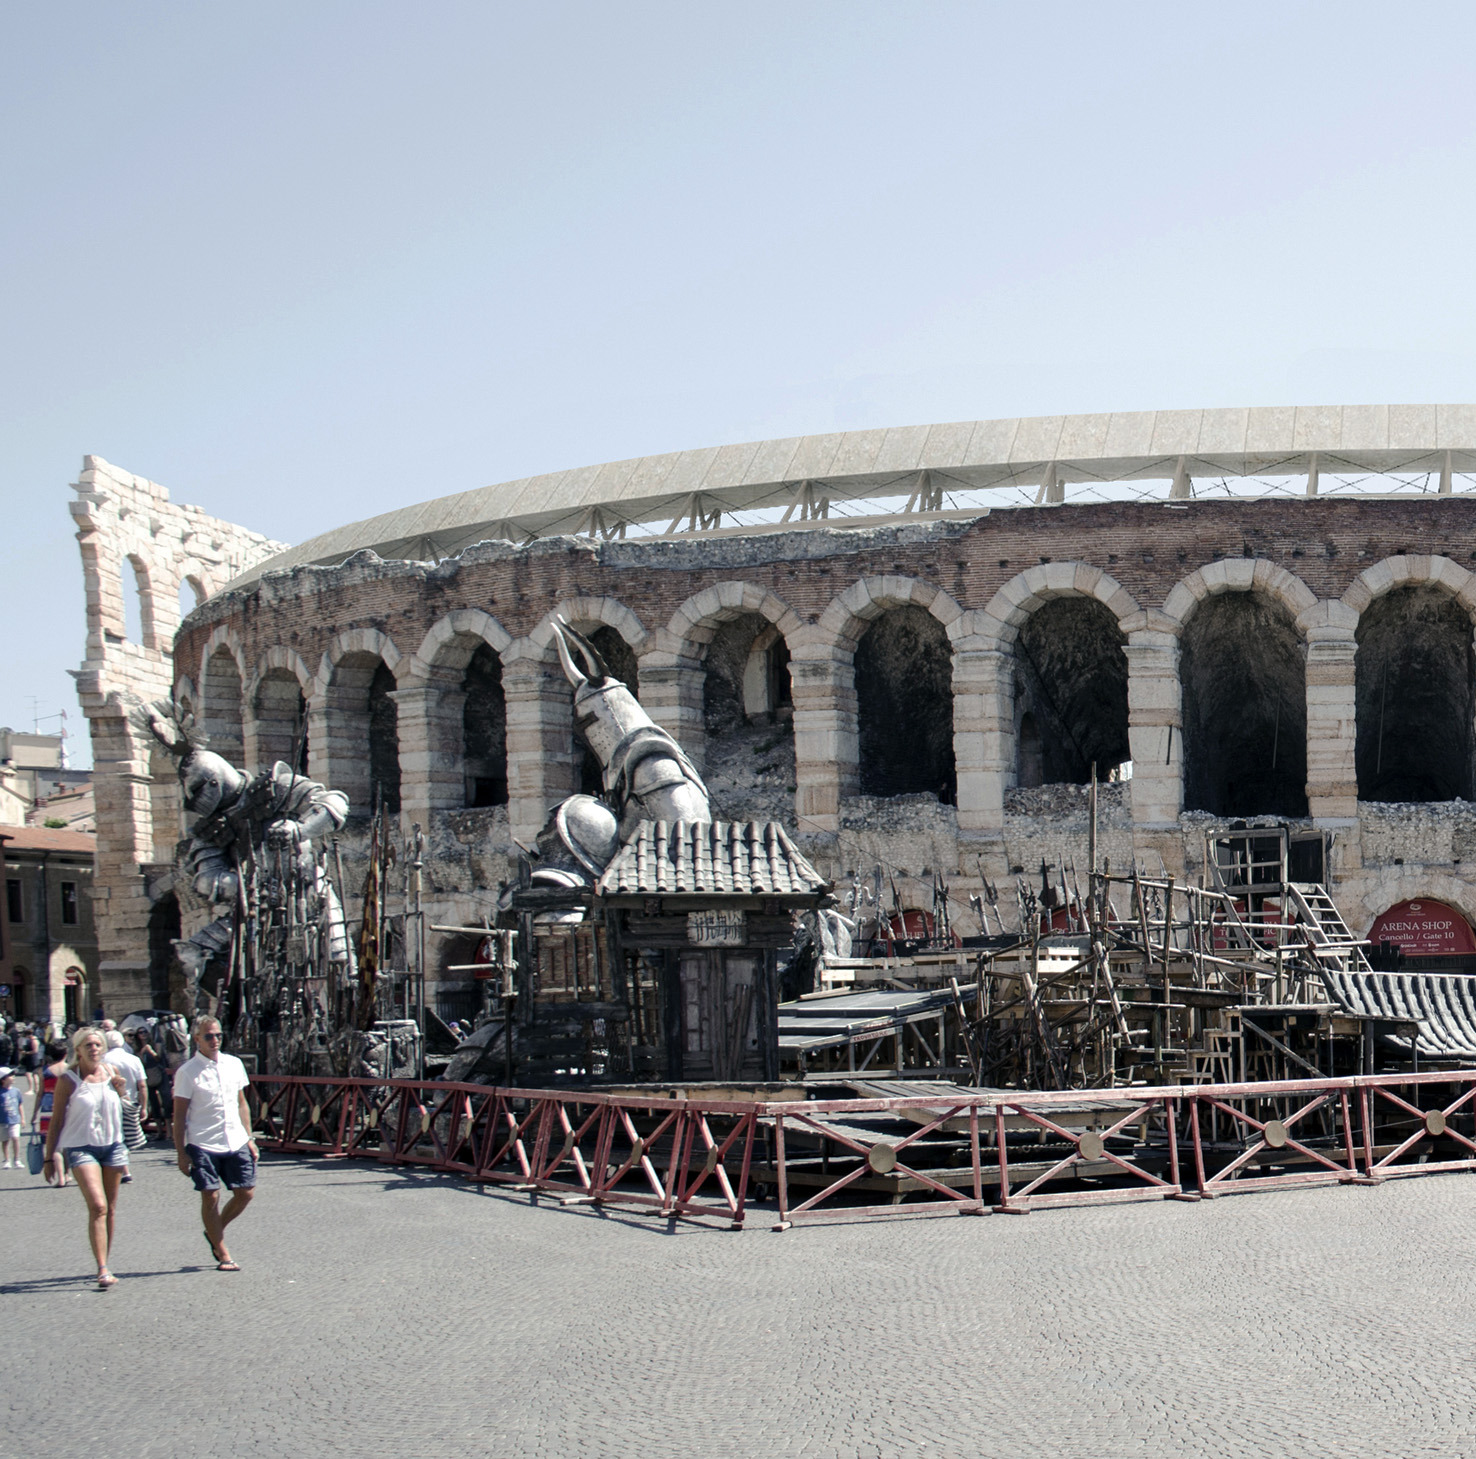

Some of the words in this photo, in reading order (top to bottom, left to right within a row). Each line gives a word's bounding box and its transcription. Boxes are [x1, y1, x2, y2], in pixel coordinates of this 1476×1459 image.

[1381, 921, 1420, 931] ARENA
[1422, 921, 1452, 930] SHOP
[1422, 932, 1442, 940] Gate
[1444, 931, 1455, 939] 10
